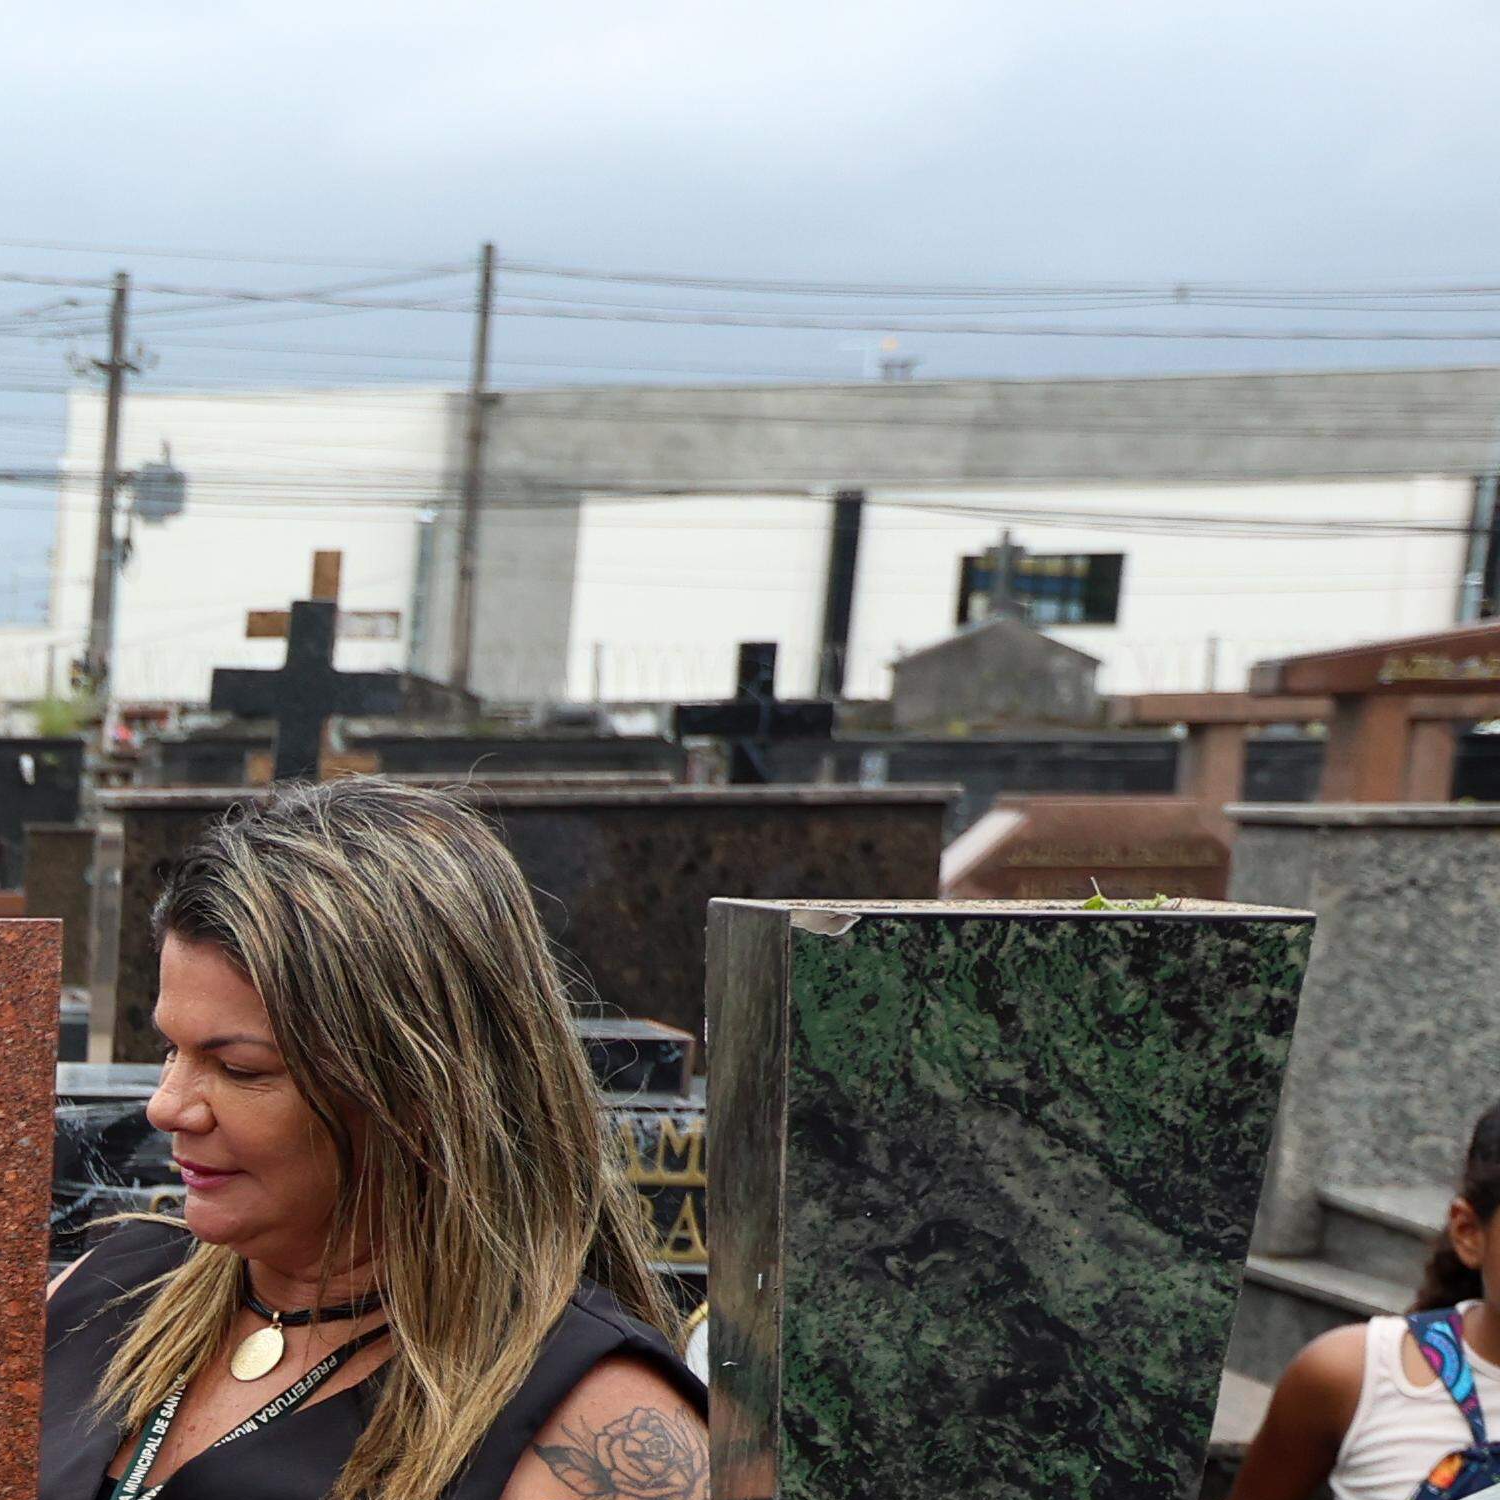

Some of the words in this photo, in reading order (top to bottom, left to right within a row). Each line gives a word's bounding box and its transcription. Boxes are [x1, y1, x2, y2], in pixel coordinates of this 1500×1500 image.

[254, 1355, 338, 1424] PREFEITURA
[122, 1436, 163, 1494] MUNICIPAL
[151, 1417, 170, 1437] DE
